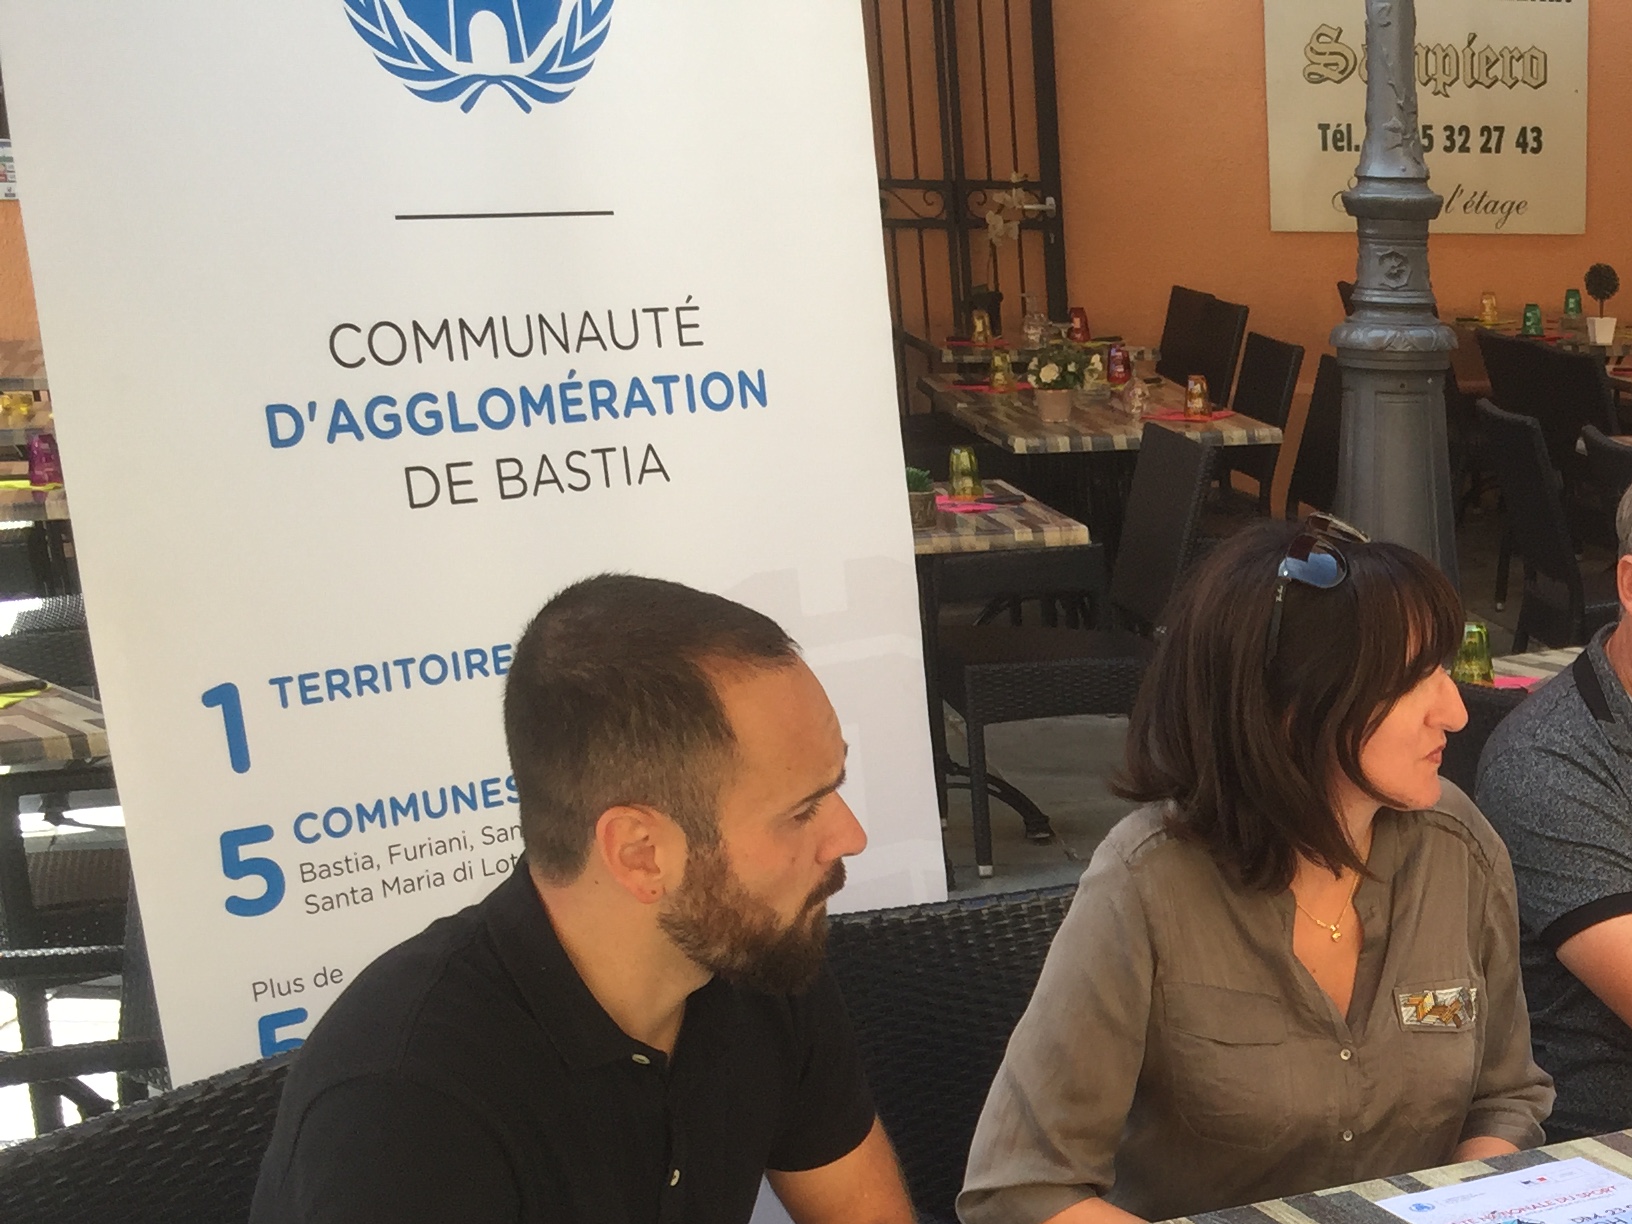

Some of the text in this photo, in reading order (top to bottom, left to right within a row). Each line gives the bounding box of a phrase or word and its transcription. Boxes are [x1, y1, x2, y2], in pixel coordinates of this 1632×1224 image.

[1303, 23, 1547, 97] Spiero
[1317, 123, 1360, 152] Tél.
[1443, 125, 1471, 153] 32
[1479, 126, 1505, 154] 27
[1515, 126, 1543, 154] 43
[328, 295, 704, 369] COMMUNAUTÉ
[265, 369, 768, 449] D'AGGLOMÉRATION
[404, 443, 671, 509] DE BASTIA
[201, 643, 512, 774] 1 TERRITOIRE
[219, 775, 520, 917] 5 COMMUNES
[300, 851, 381, 883] Bastia,
[388, 829, 474, 867] Furiani,
[304, 853, 519, 915] Santa Maria di Lot
[251, 966, 344, 1002] Plus de
